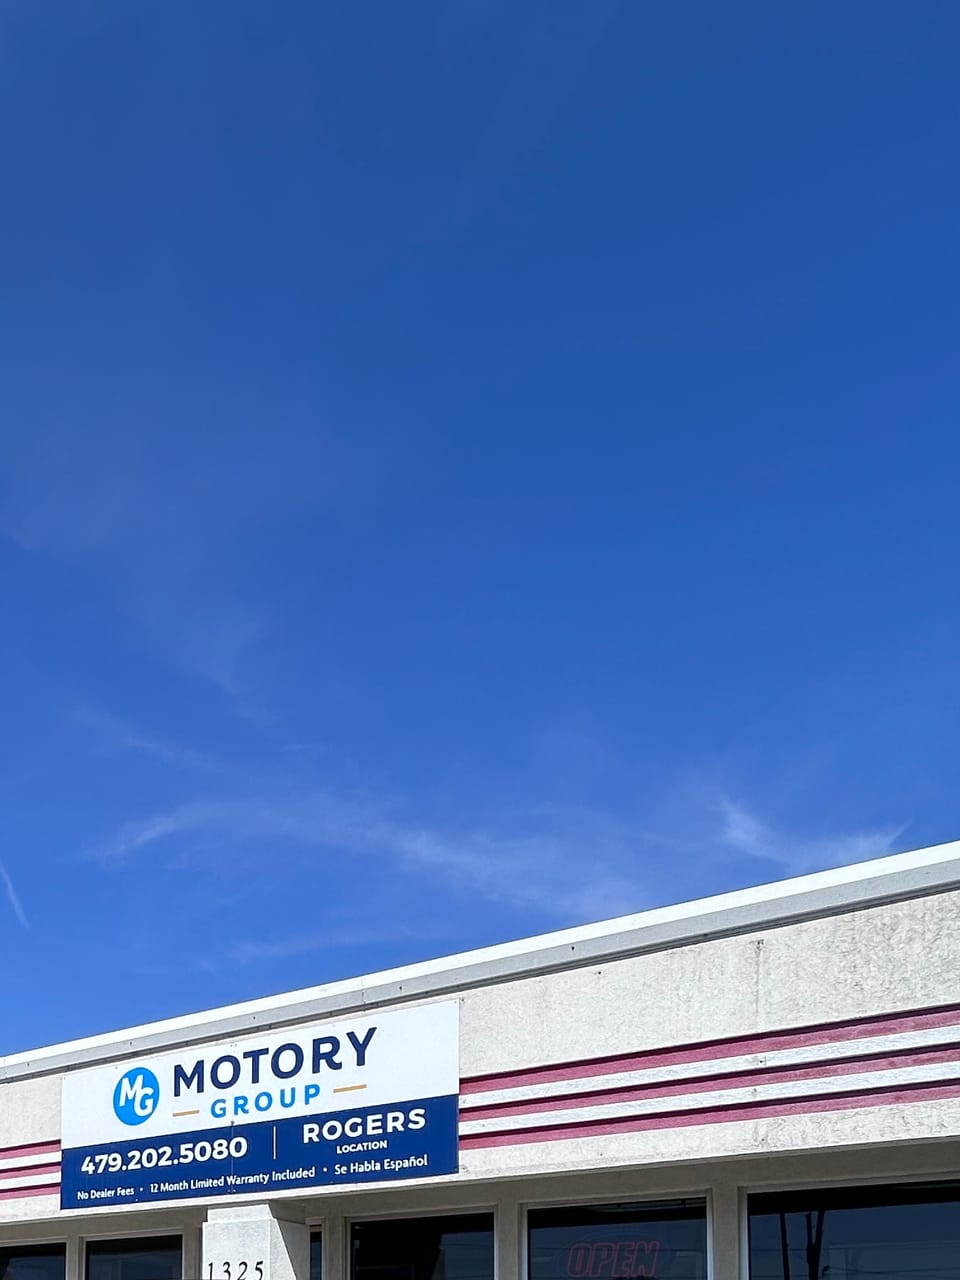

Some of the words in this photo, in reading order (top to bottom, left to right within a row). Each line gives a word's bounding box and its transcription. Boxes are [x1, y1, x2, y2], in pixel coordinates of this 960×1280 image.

[173, 1027, 378, 1098] MOTORY
[119, 1074, 155, 1117] MG
[210, 1084, 321, 1119] GROUP
[303, 1108, 427, 1144] ROGERS
[80, 1136, 248, 1175] 479.202.5080
[334, 1164, 347, 1175] Se
[350, 1159, 381, 1174] Habla
[384, 1154, 428, 1172] Español
[336, 1140, 388, 1154] LOCATION
[77, 1191, 89, 1201] No
[90, 1187, 115, 1199] Dealer
[116, 1186, 135, 1197] Fees
[150, 1183, 159, 1193] 12
[160, 1179, 189, 1193] Month
[190, 1175, 224, 1189] Limited
[226, 1171, 270, 1186] Warranty
[271, 1166, 316, 1182] Included
[567, 1240, 660, 1278] OPEN
